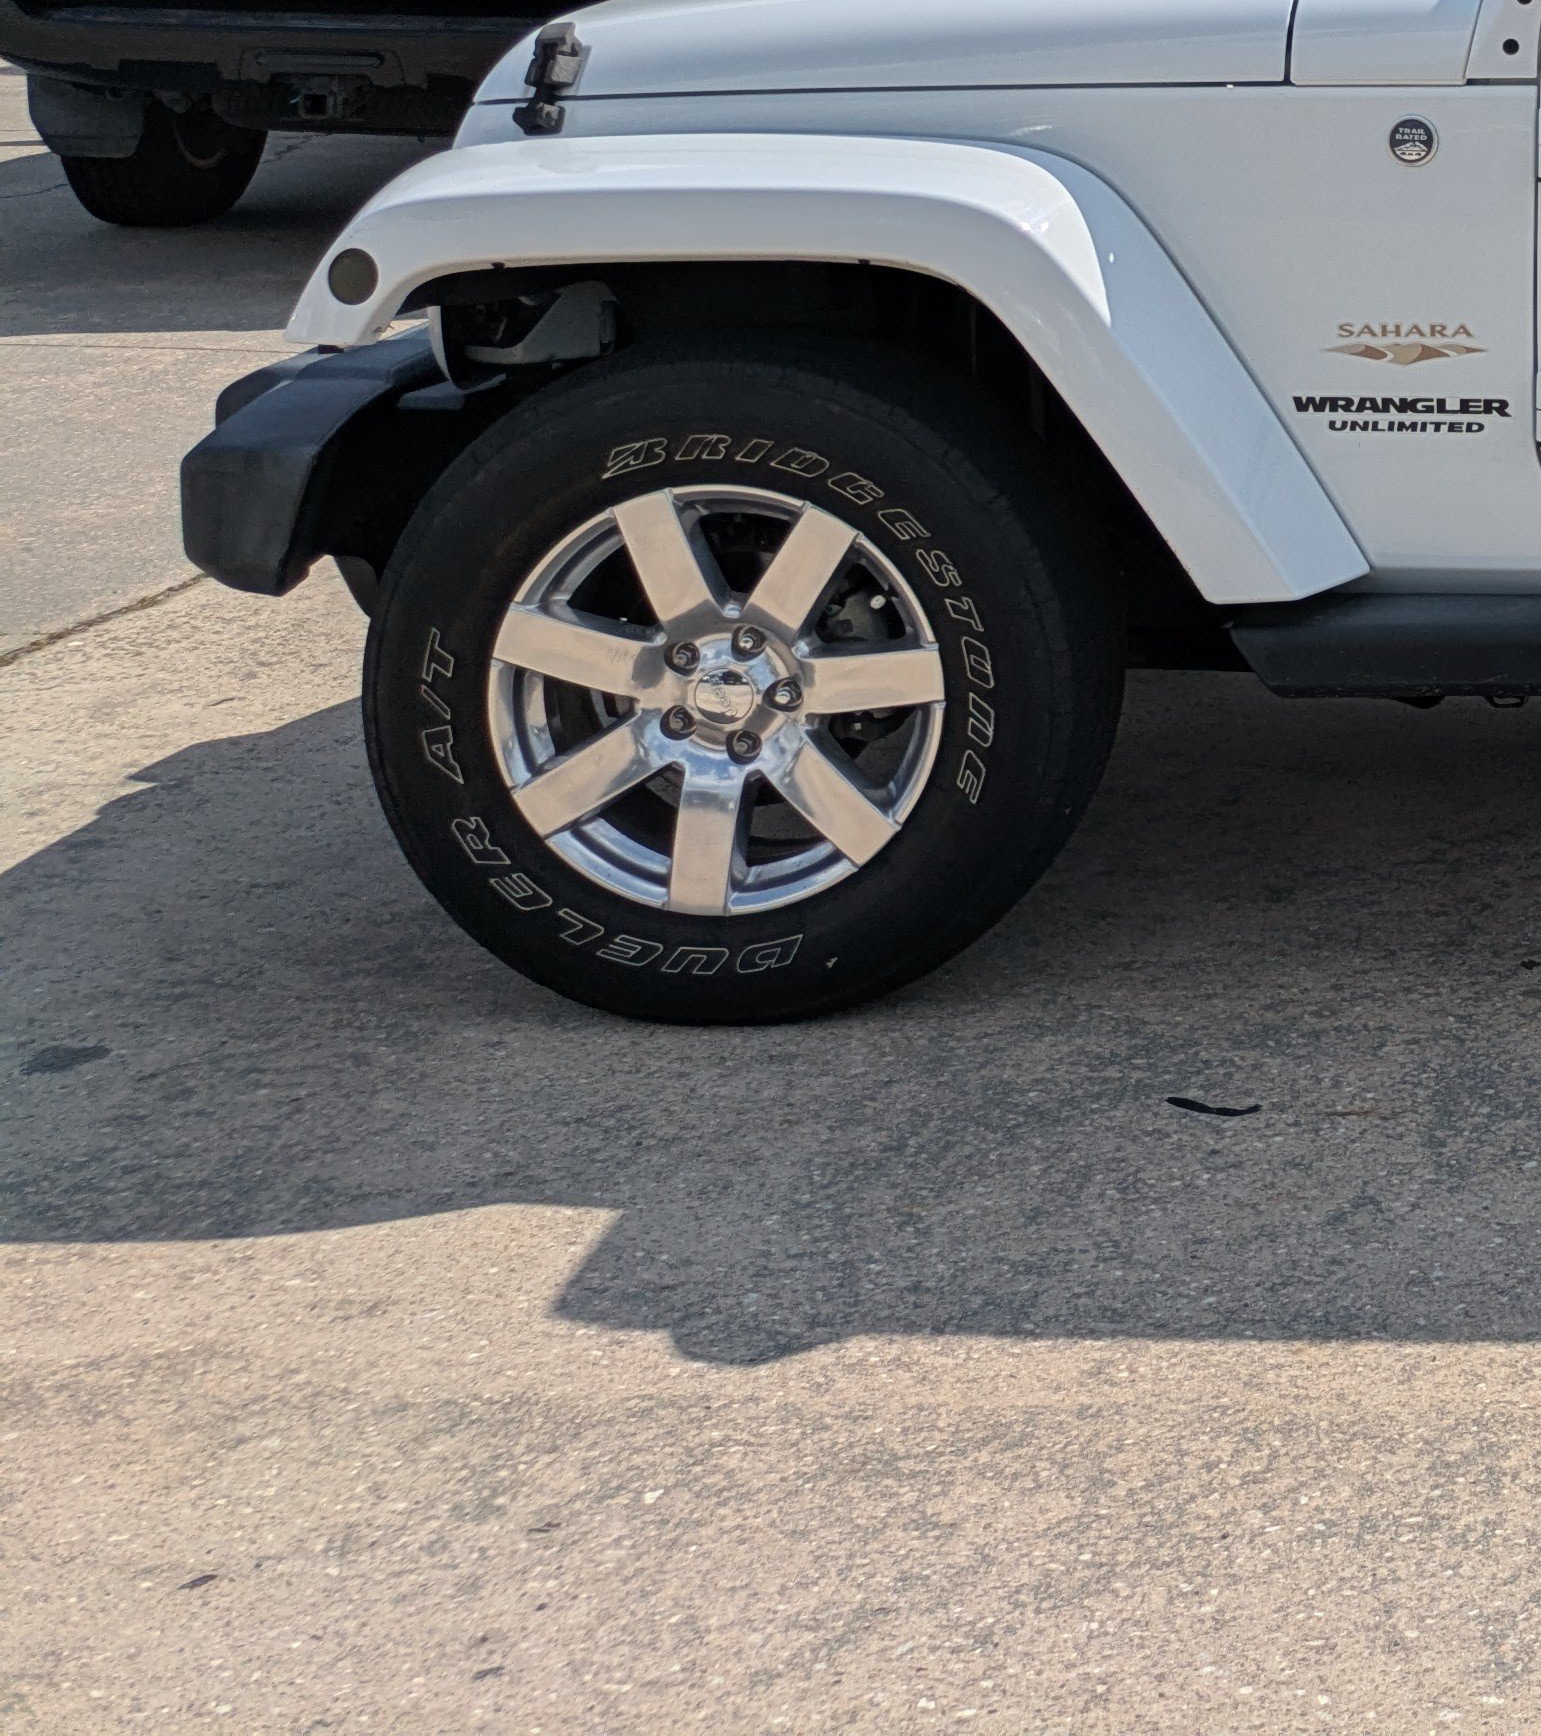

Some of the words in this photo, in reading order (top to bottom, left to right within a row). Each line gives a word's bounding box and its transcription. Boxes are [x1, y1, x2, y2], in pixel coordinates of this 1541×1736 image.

[1337, 322, 1475, 338] SAHARA
[1292, 395, 1513, 418] WRANGLER
[1328, 420, 1485, 434] UNLIMITED
[601, 434, 996, 805] BRIDGESTONE
[422, 627, 464, 784] A/T
[451, 816, 804, 975] DUELER
